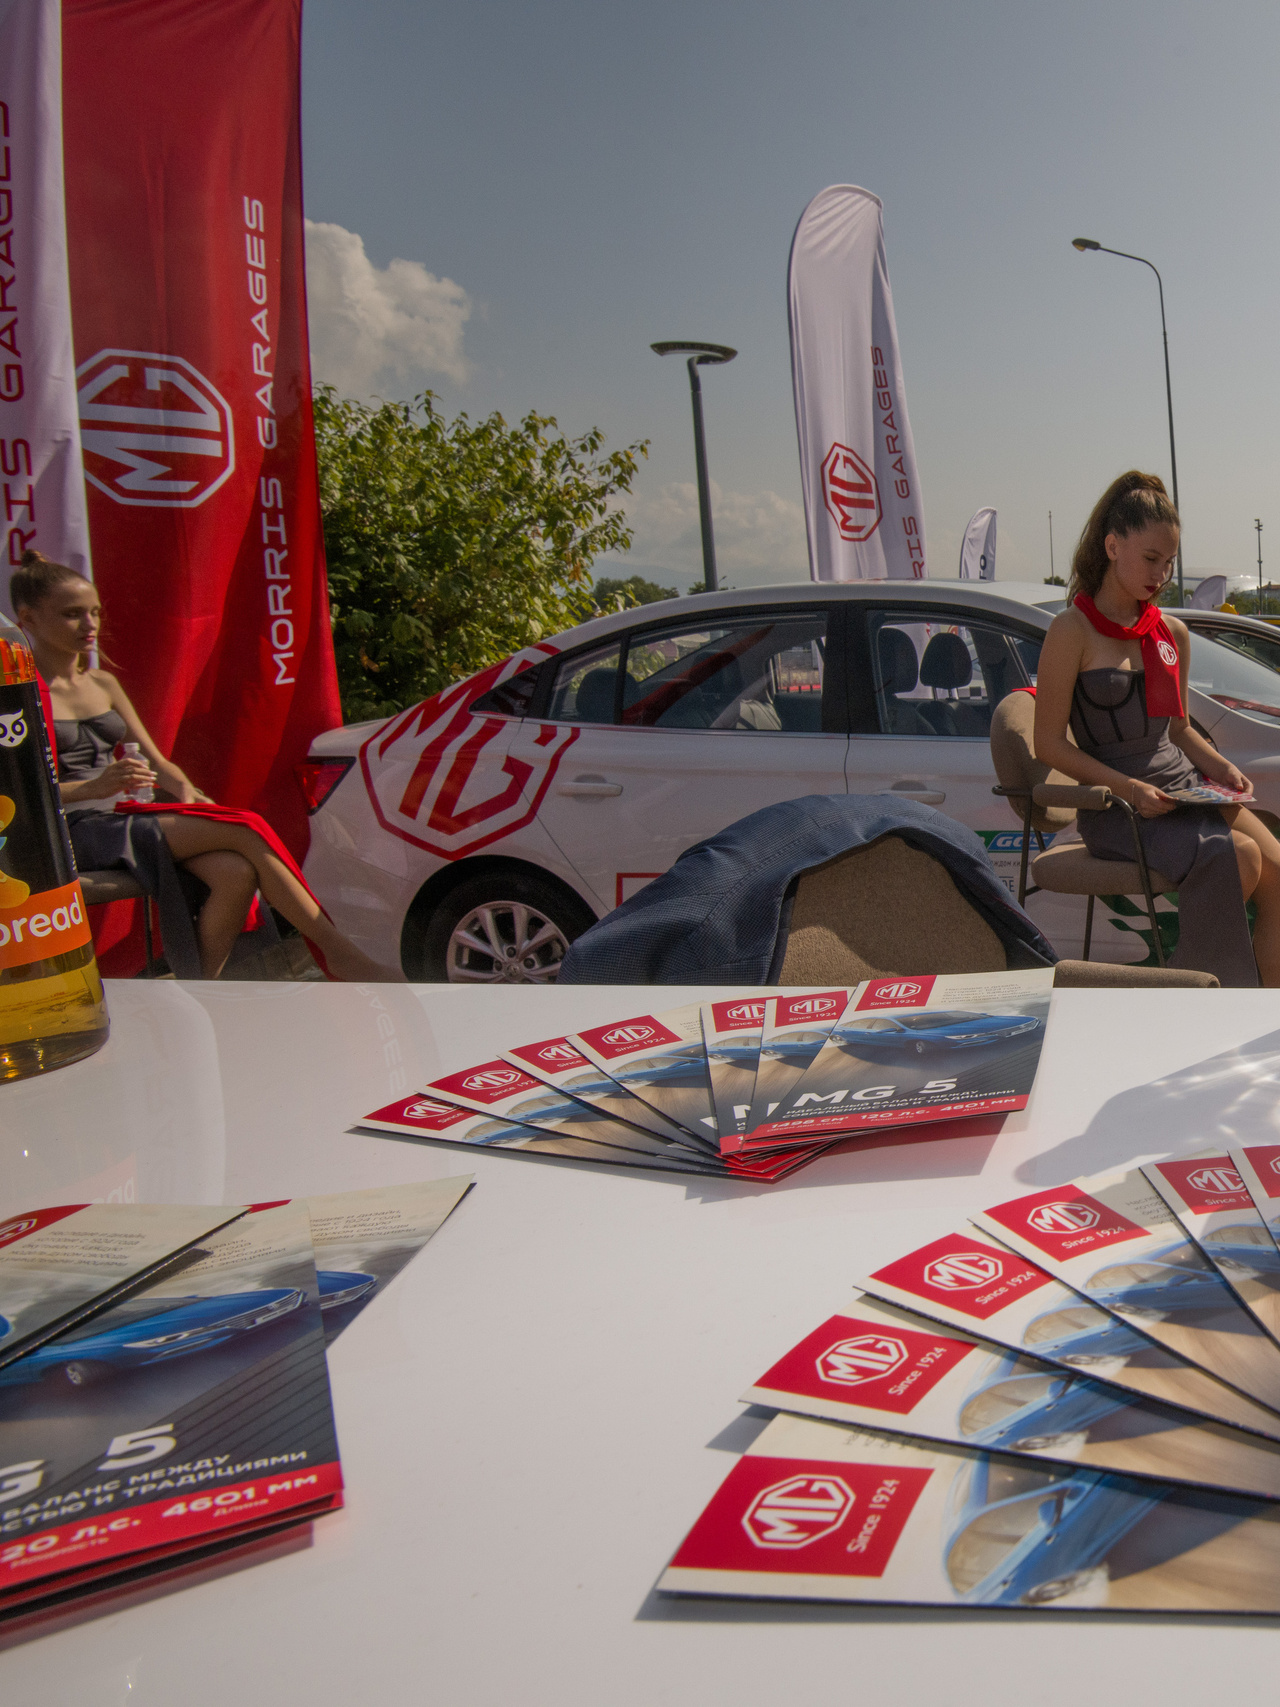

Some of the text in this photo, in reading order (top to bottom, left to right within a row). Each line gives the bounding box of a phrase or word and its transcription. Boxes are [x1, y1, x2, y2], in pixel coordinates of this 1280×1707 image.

[870, 346, 911, 500] GARAGES
[243, 195, 296, 686] MORRIS GARAGES
[827, 452, 877, 533] MG
[1158, 642, 1176, 664] MG
[870, 998, 917, 1007] Since 1924
[879, 984, 918, 998] MG
[788, 1011, 838, 1022] Since 1924
[792, 1000, 833, 1014] MG
[605, 1027, 652, 1045] MG
[729, 1020, 754, 1028] Since
[614, 1036, 667, 1053] Since 1924
[556, 1059, 583, 1068] Since
[465, 1070, 519, 1089] MG
[489, 1086, 517, 1097] Since
[792, 1077, 958, 1108] MG 5
[771, 1119, 815, 1130] 1498
[860, 1112, 893, 1120] 120
[939, 1101, 985, 1112] 4601
[782, 1101, 911, 1119] СОВРЕМЕННОСТЬЮ
[925, 1088, 1016, 1104] ТРАДИЦИЯМИ
[786, 1089, 980, 1115] ИДЕАЛЬНЫЙ БАЛАНС МЕЖДУ
[437, 1112, 464, 1124] Since
[1204, 1196, 1238, 1207] Since
[1033, 1204, 1092, 1232] MG
[1061, 1224, 1127, 1250] Since 1924
[931, 1254, 995, 1288] MG
[974, 1269, 1037, 1306] Since 1924
[827, 1336, 901, 1383] MG
[887, 1345, 948, 1398] Since 1924
[97, 1422, 178, 1472] 5
[1, 1453, 231, 1522] БАЛАНС МЕЖДУ
[92, 1492, 115, 1507] И
[122, 1450, 309, 1498] ТРАДИЦИЯМИ
[160, 1486, 257, 1519] 4601
[754, 1480, 847, 1542] MG
[846, 1513, 881, 1554] Since
[867, 1478, 900, 1510] 1924
